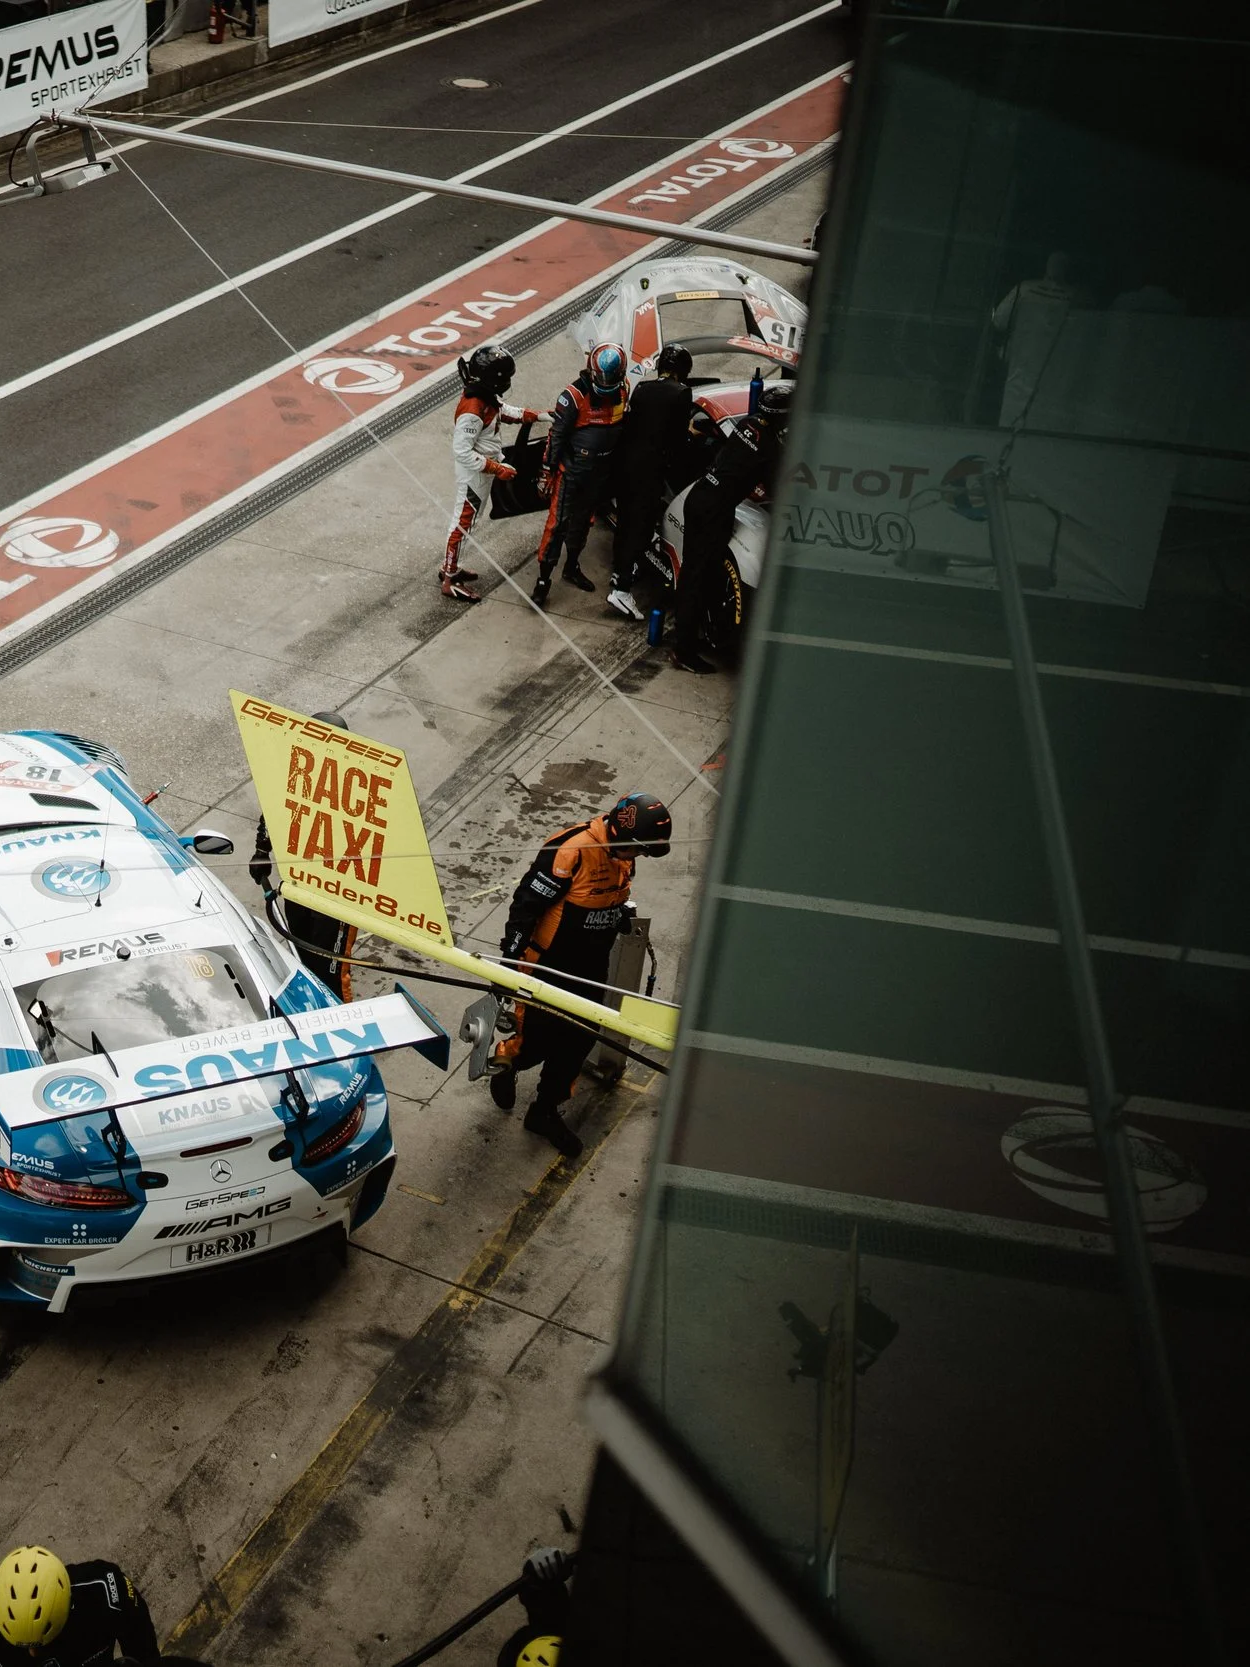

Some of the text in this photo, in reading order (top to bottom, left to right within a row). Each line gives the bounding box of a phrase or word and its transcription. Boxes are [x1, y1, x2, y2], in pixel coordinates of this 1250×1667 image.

[628, 157, 757, 205] TOTAL
[363, 287, 538, 356] TOTAL
[770, 322, 796, 349] 15
[26, 765, 62, 783] 18
[287, 744, 392, 829] RACE
[285, 798, 385, 888] TAXI
[289, 866, 442, 935] under8.de
[58, 933, 167, 965] REMUS
[187, 953, 215, 979] 18
[135, 1022, 388, 1098] KNAUS
[338, 1072, 363, 1105] REMUS
[158, 1096, 231, 1125] KNAUS
[208, 1197, 291, 1228] AMG
[89, 1236, 118, 1244] BROKER
[24, 1258, 69, 1273] MICHELIN
[106, 1573, 119, 1603] sparco
